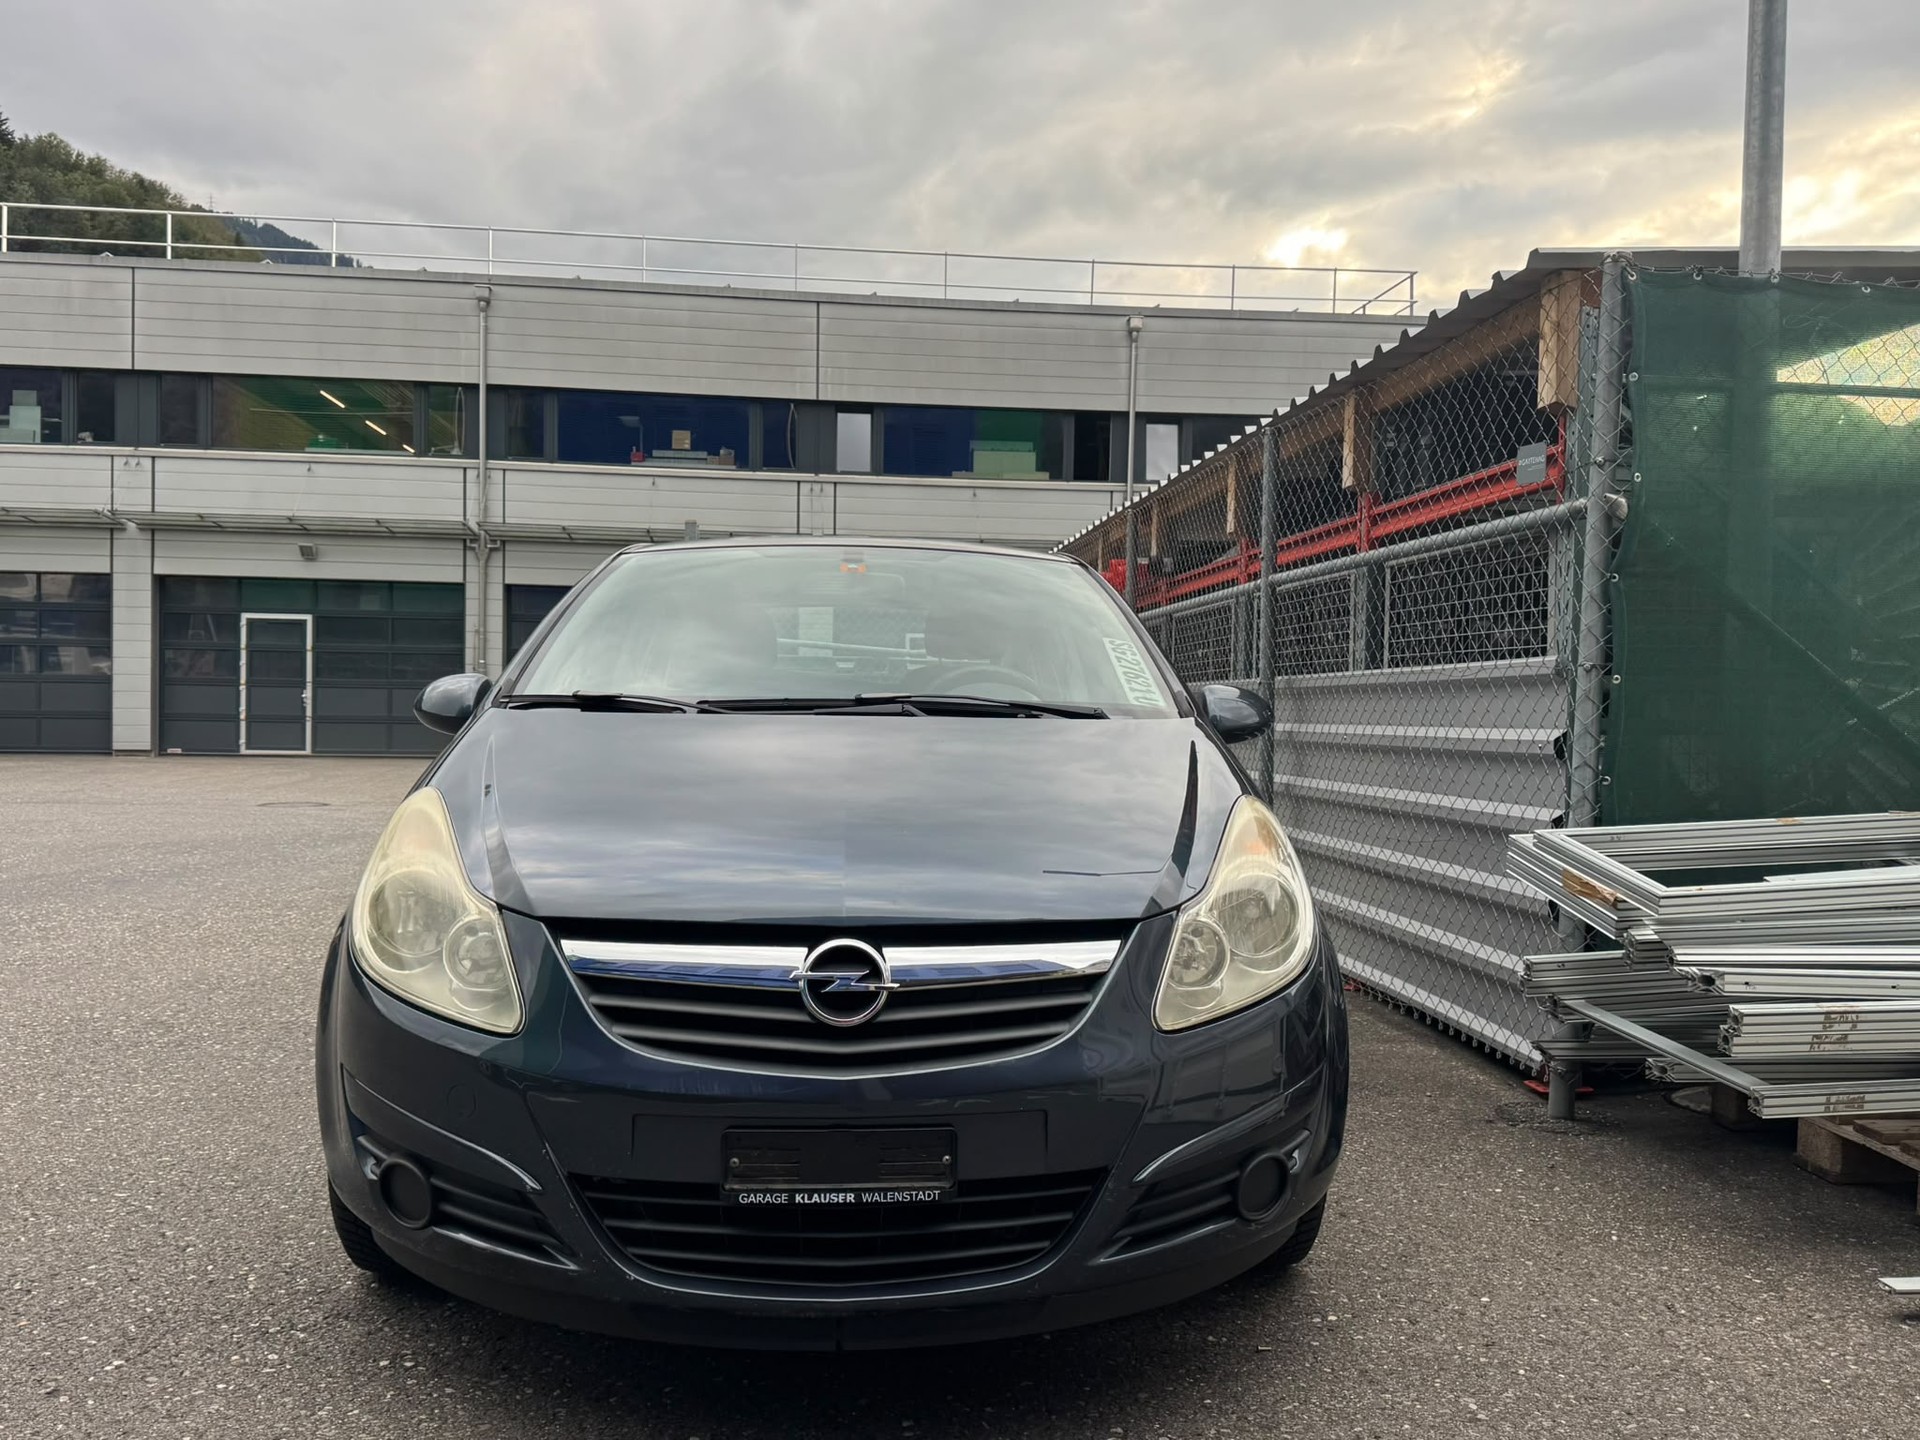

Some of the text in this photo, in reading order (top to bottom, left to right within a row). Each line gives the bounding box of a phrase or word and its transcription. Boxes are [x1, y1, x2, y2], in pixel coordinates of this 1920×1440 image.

[738, 1190, 941, 1204] GARAGE KLAUSER WALENSTADT
